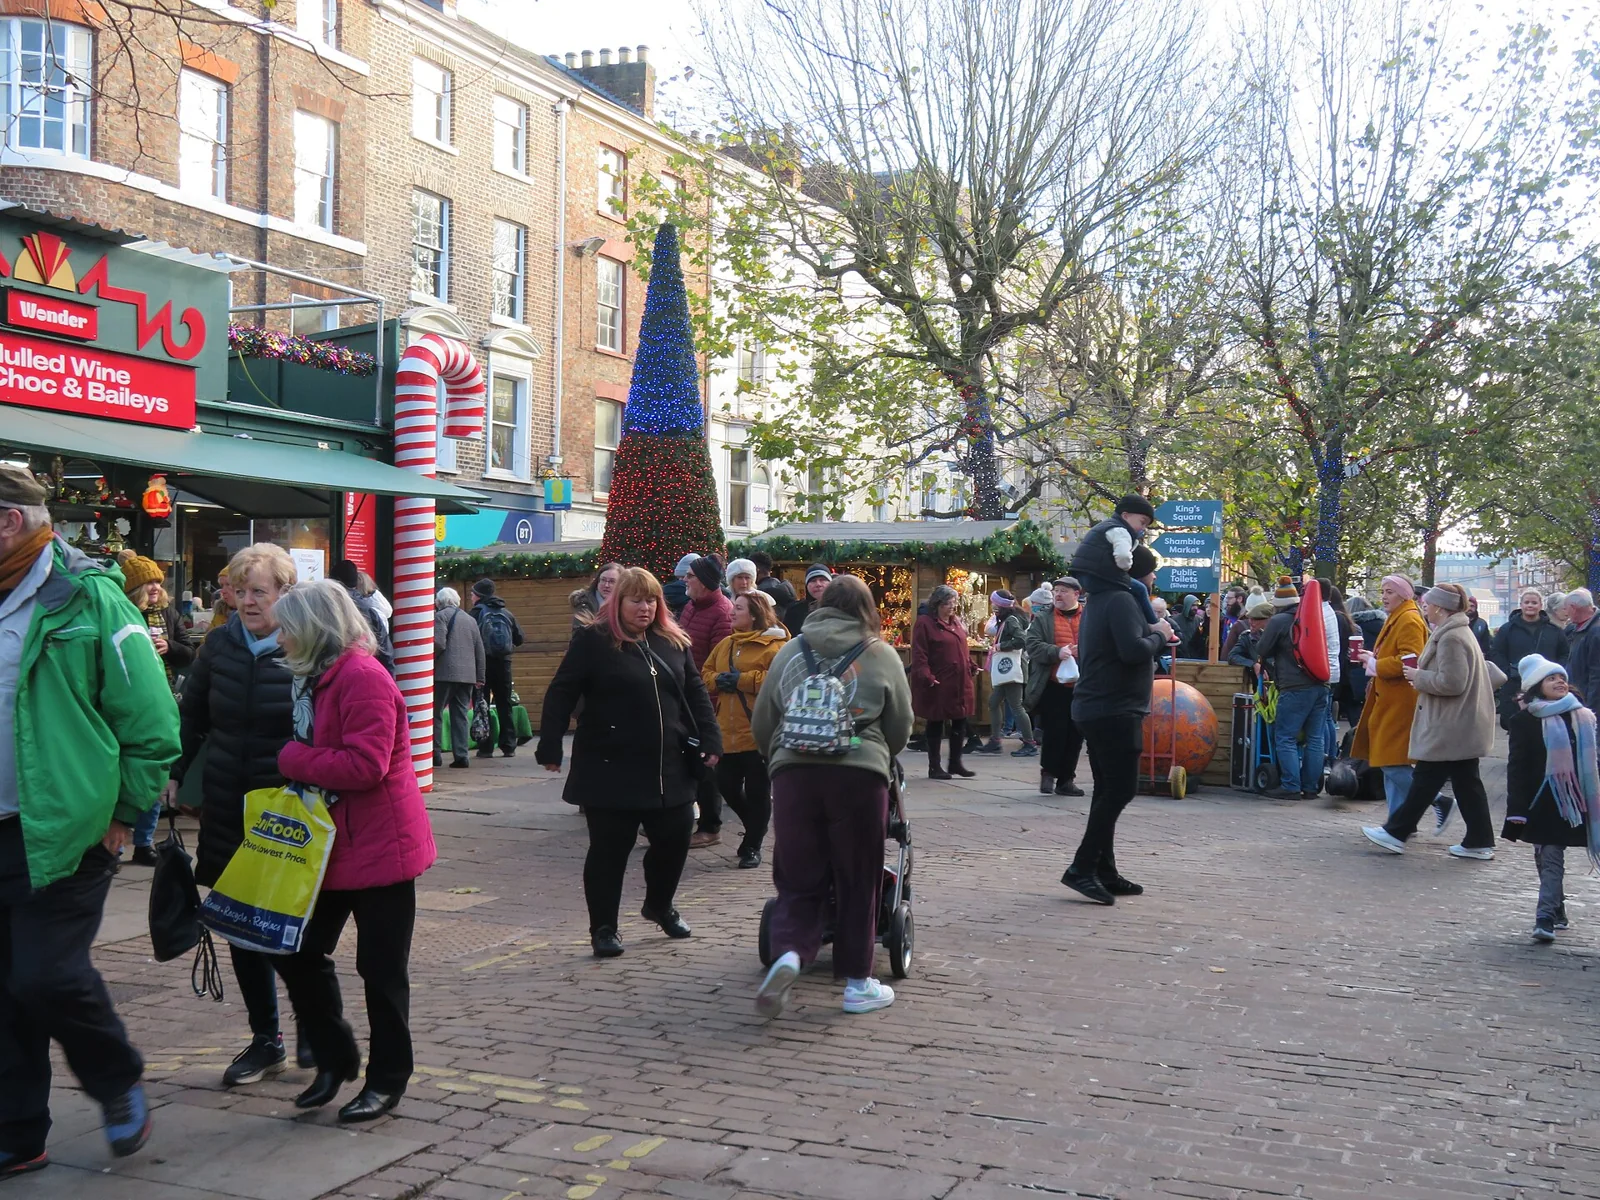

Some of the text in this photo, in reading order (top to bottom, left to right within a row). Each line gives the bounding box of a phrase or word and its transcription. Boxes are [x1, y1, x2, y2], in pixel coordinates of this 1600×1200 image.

[0, 343, 131, 385] ulled Wine
[62, 377, 83, 399] &
[88, 381, 169, 414] Baileys
[1175, 505, 1200, 514] King's
[1172, 513, 1203, 522] Square
[520, 528, 529, 538] BT
[1164, 538, 1205, 546] Shambles
[1169, 546, 1200, 554] Market
[1171, 568, 1197, 576] Public
[1170, 575, 1198, 583] Toilets
[285, 852, 306, 864] Prices
[252, 914, 282, 933] Replace
